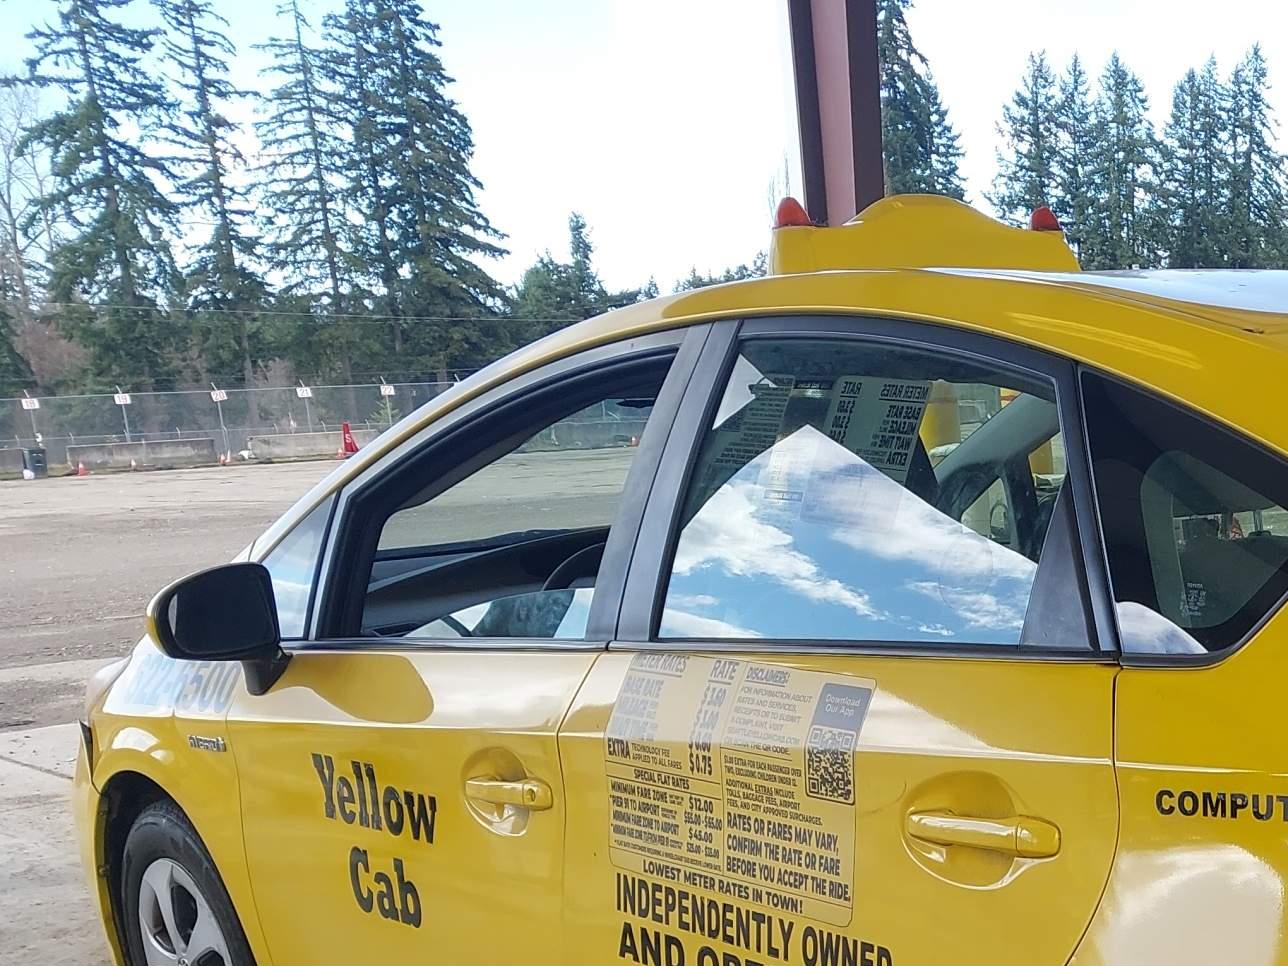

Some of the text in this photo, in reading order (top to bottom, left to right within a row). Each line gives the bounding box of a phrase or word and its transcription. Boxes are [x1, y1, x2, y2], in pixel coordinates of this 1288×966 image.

[711, 660, 740, 680] RATE
[826, 694, 861, 707] Download
[826, 703, 855, 717] Our App
[608, 737, 631, 760] EXTRA
[689, 751, 712, 776] $0.75
[634, 768, 690, 790] SPECIAL FLAT RATES
[726, 779, 795, 799] ADDITIONAL EXTRAS INCLUDE
[311, 753, 437, 845] Yellow
[611, 780, 636, 796] MINIMUM
[636, 785, 652, 800] FARE
[652, 789, 668, 804] ZONE
[630, 798, 637, 812] TO
[638, 801, 660, 817] AIRPORT
[689, 795, 714, 814] $12.00
[740, 801, 750, 811] AND
[751, 803, 762, 813] CITY
[763, 806, 789, 819] APPROVED
[780, 800, 800, 811] AIRPORT
[688, 827, 713, 844] $45.00
[727, 812, 839, 856] RATES OR FARES MAY VARY,
[727, 834, 762, 857] CONFIRM
[764, 842, 780, 861] THE
[781, 847, 803, 868] RATE
[804, 852, 817, 871] OR
[818, 855, 841, 876] FARE
[349, 846, 423, 929] Cab
[643, 860, 803, 914] LOWEST METER RATES IN TOWN!
[726, 856, 851, 902] BEFORE YOU ACCEPT THE RIDE.
[616, 872, 794, 962] INDEPENDENTLY
